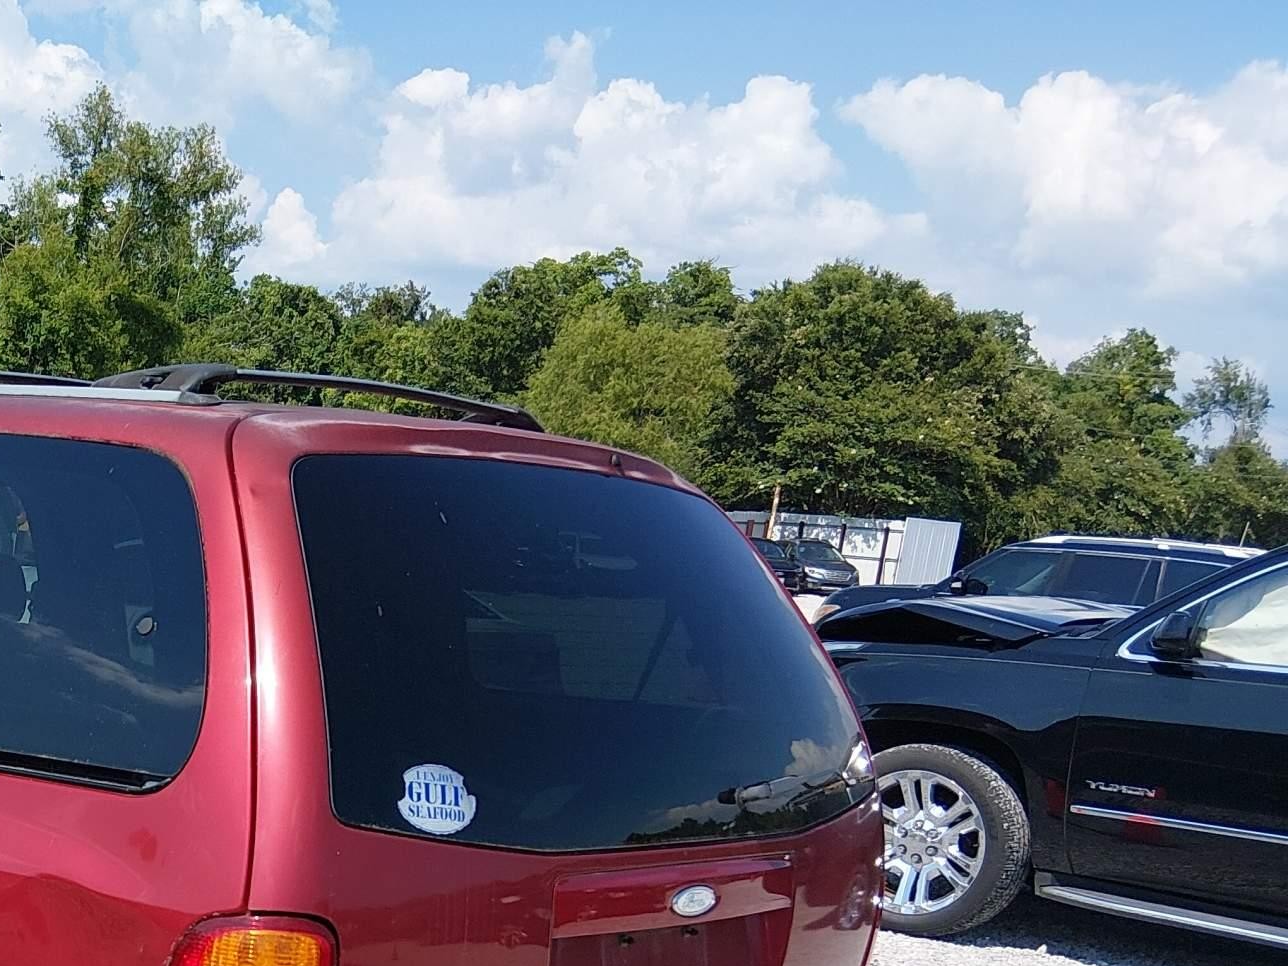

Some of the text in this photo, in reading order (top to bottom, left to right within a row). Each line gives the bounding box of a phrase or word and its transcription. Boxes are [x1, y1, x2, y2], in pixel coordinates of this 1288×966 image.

[423, 771, 454, 784] ENJOY
[407, 781, 465, 807] GULF
[407, 804, 466, 822] SEAFOOD
